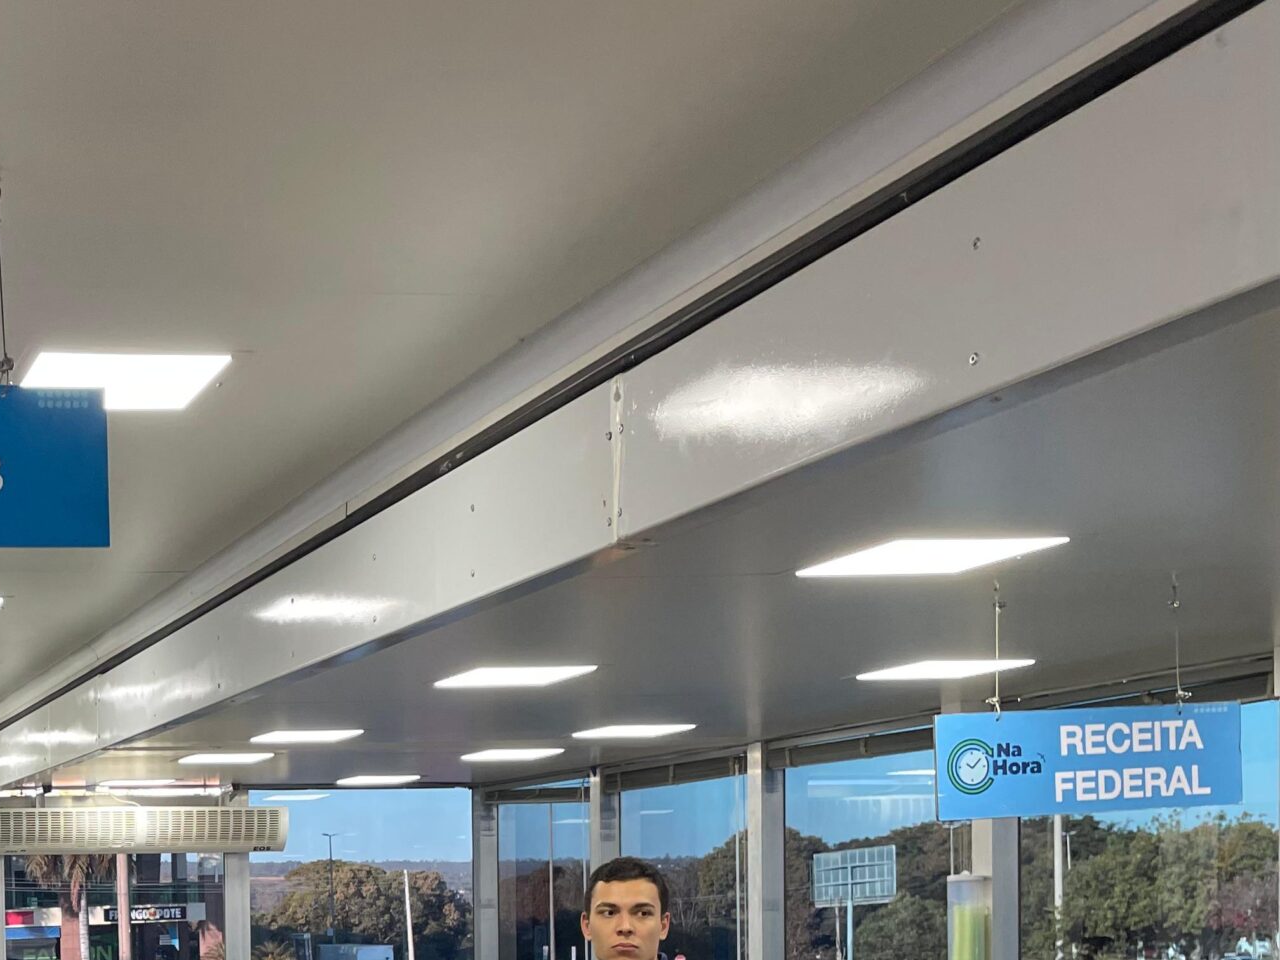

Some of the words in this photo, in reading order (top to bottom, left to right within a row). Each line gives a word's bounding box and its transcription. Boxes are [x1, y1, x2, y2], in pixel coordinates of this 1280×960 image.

[997, 742, 1022, 758] Na
[1059, 719, 1204, 756] RECEITA
[992, 759, 1042, 776] Hora
[1054, 765, 1211, 802] FEDERAL
